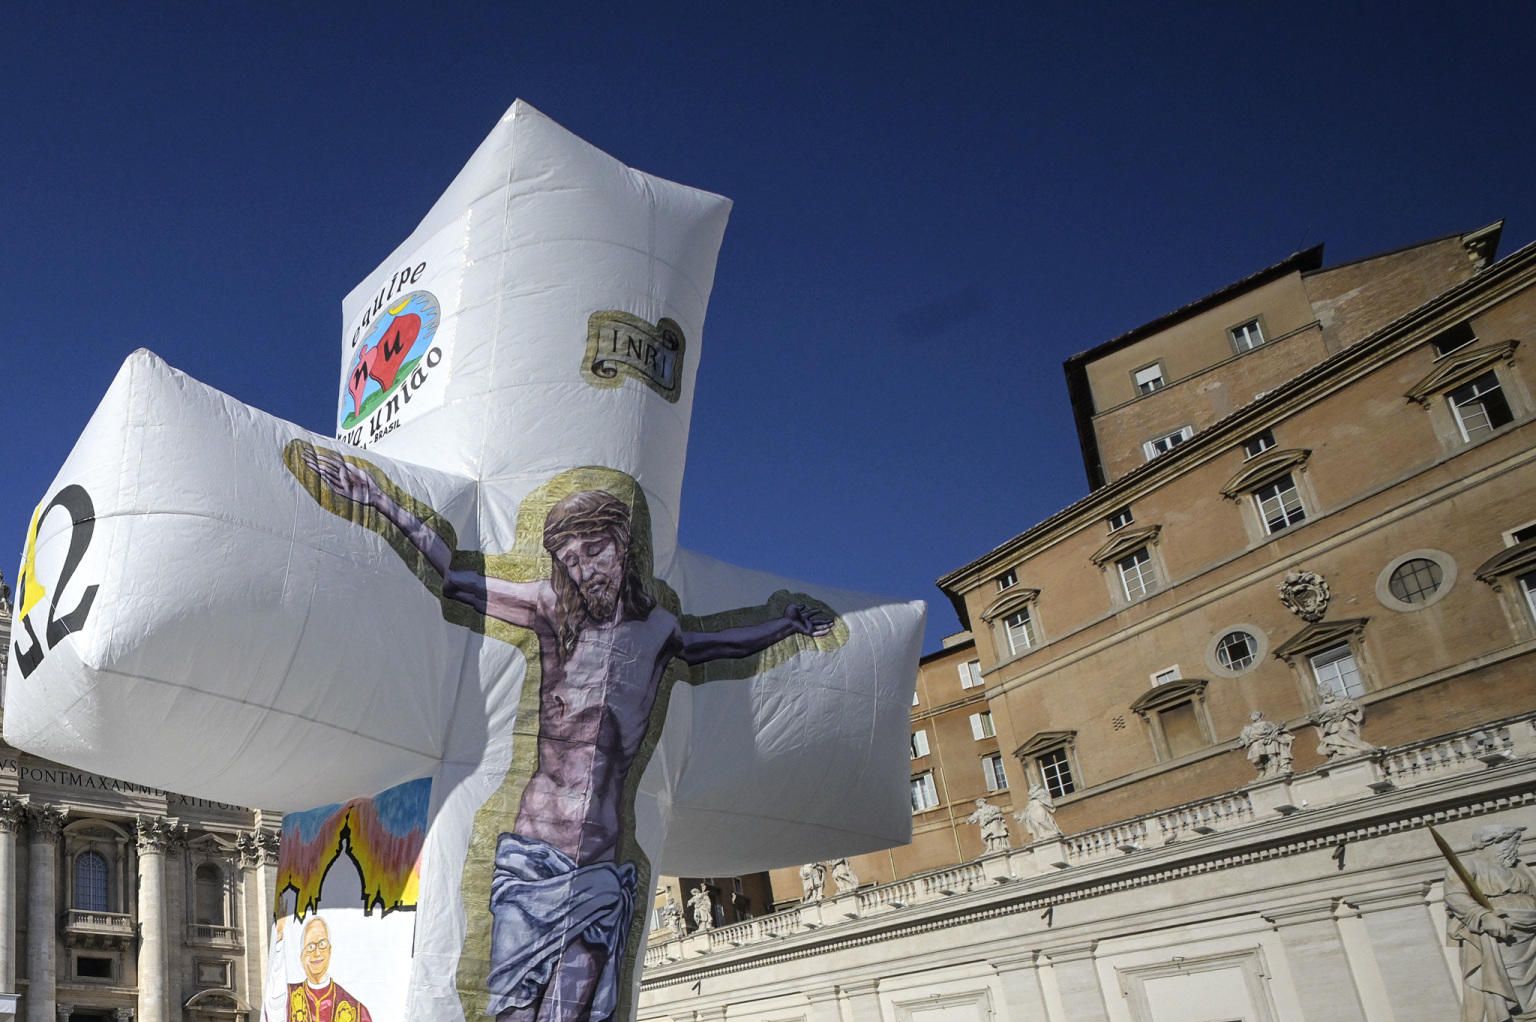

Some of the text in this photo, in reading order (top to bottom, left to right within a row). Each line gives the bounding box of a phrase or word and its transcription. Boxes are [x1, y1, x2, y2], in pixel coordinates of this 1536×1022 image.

[352, 261, 426, 348] equipe
[370, 346, 443, 437] união
[612, 329, 666, 378] INRI
